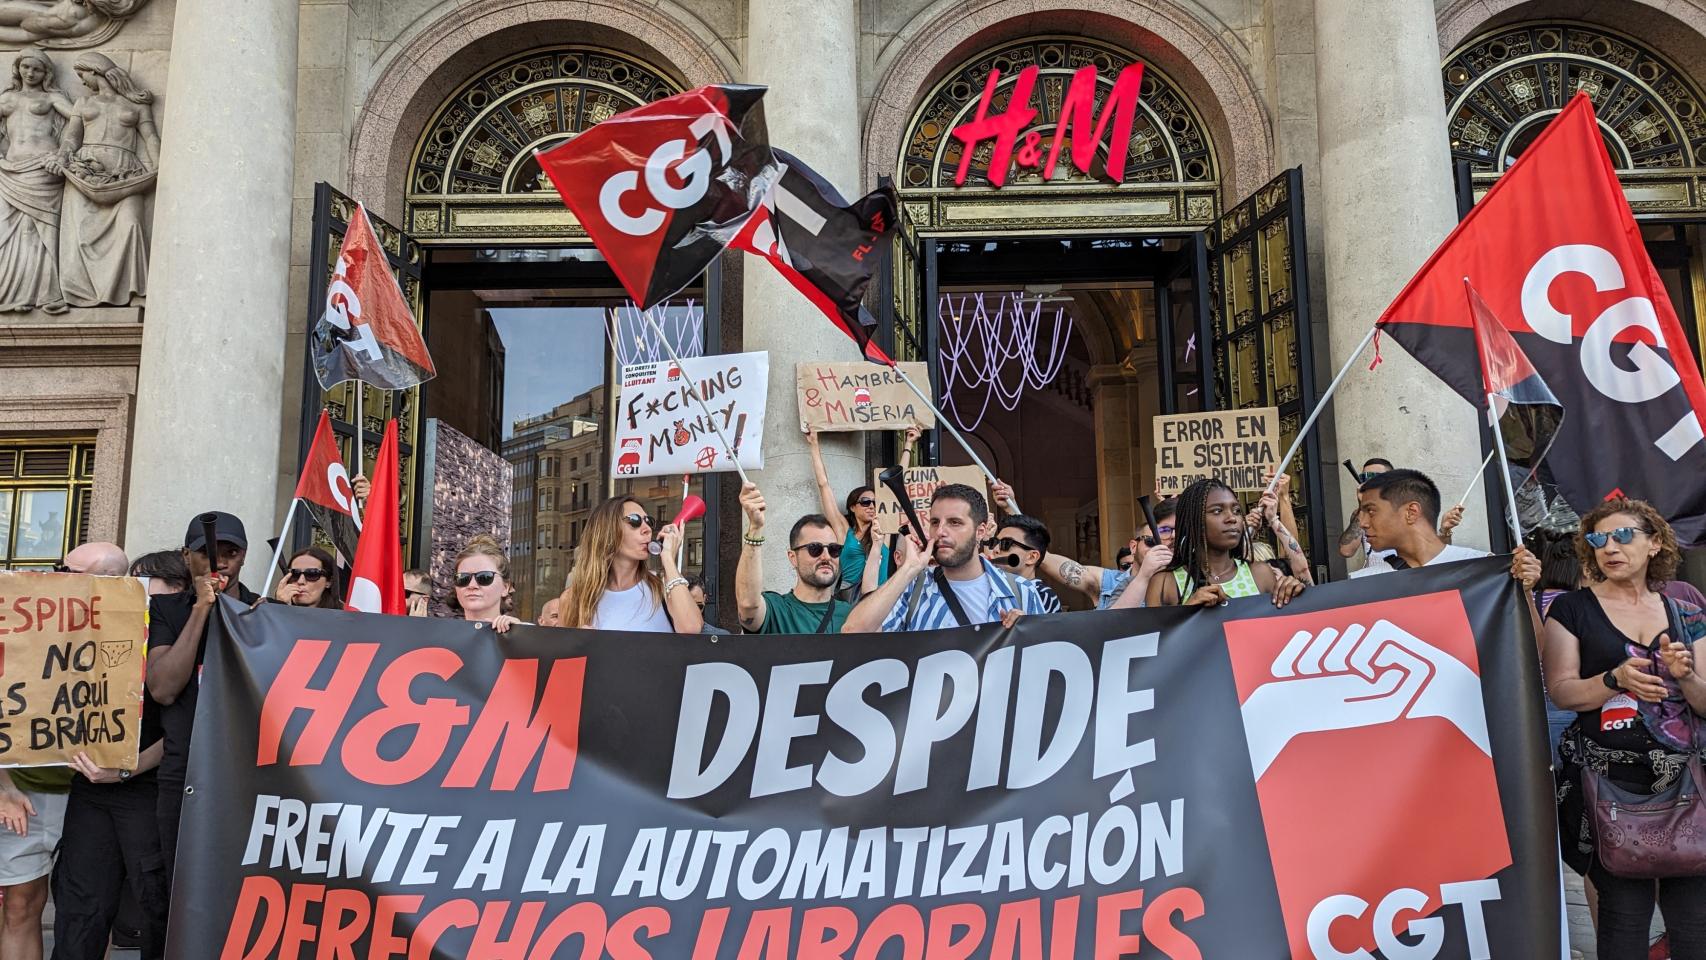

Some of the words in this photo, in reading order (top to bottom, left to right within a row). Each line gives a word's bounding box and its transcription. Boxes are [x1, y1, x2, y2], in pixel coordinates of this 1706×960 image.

[952, 62, 1144, 187] H&M
[599, 113, 732, 236] CGT
[624, 377, 656, 387] LLUITANT
[817, 367, 907, 391] HAMBRE
[806, 388, 822, 407] &
[825, 400, 916, 424] MISERIA
[1163, 418, 1224, 442] ERROR
[1236, 415, 1266, 438] EN
[617, 464, 639, 474] CGT
[1162, 446, 1184, 469] EL
[0, 596, 101, 634] ESPIDE
[42, 640, 97, 680] NO
[28, 708, 125, 751] BRAGAS
[257, 638, 588, 793] H&M
[667, 631, 1160, 799] DESPIDE
[1602, 718, 1634, 731] CGT
[241, 794, 462, 886] FRENTE
[453, 818, 516, 892] A
[521, 821, 606, 895] LA
[611, 768, 1184, 900] AUTOMATIZACIÓN
[1306, 878, 1502, 960] CGT
